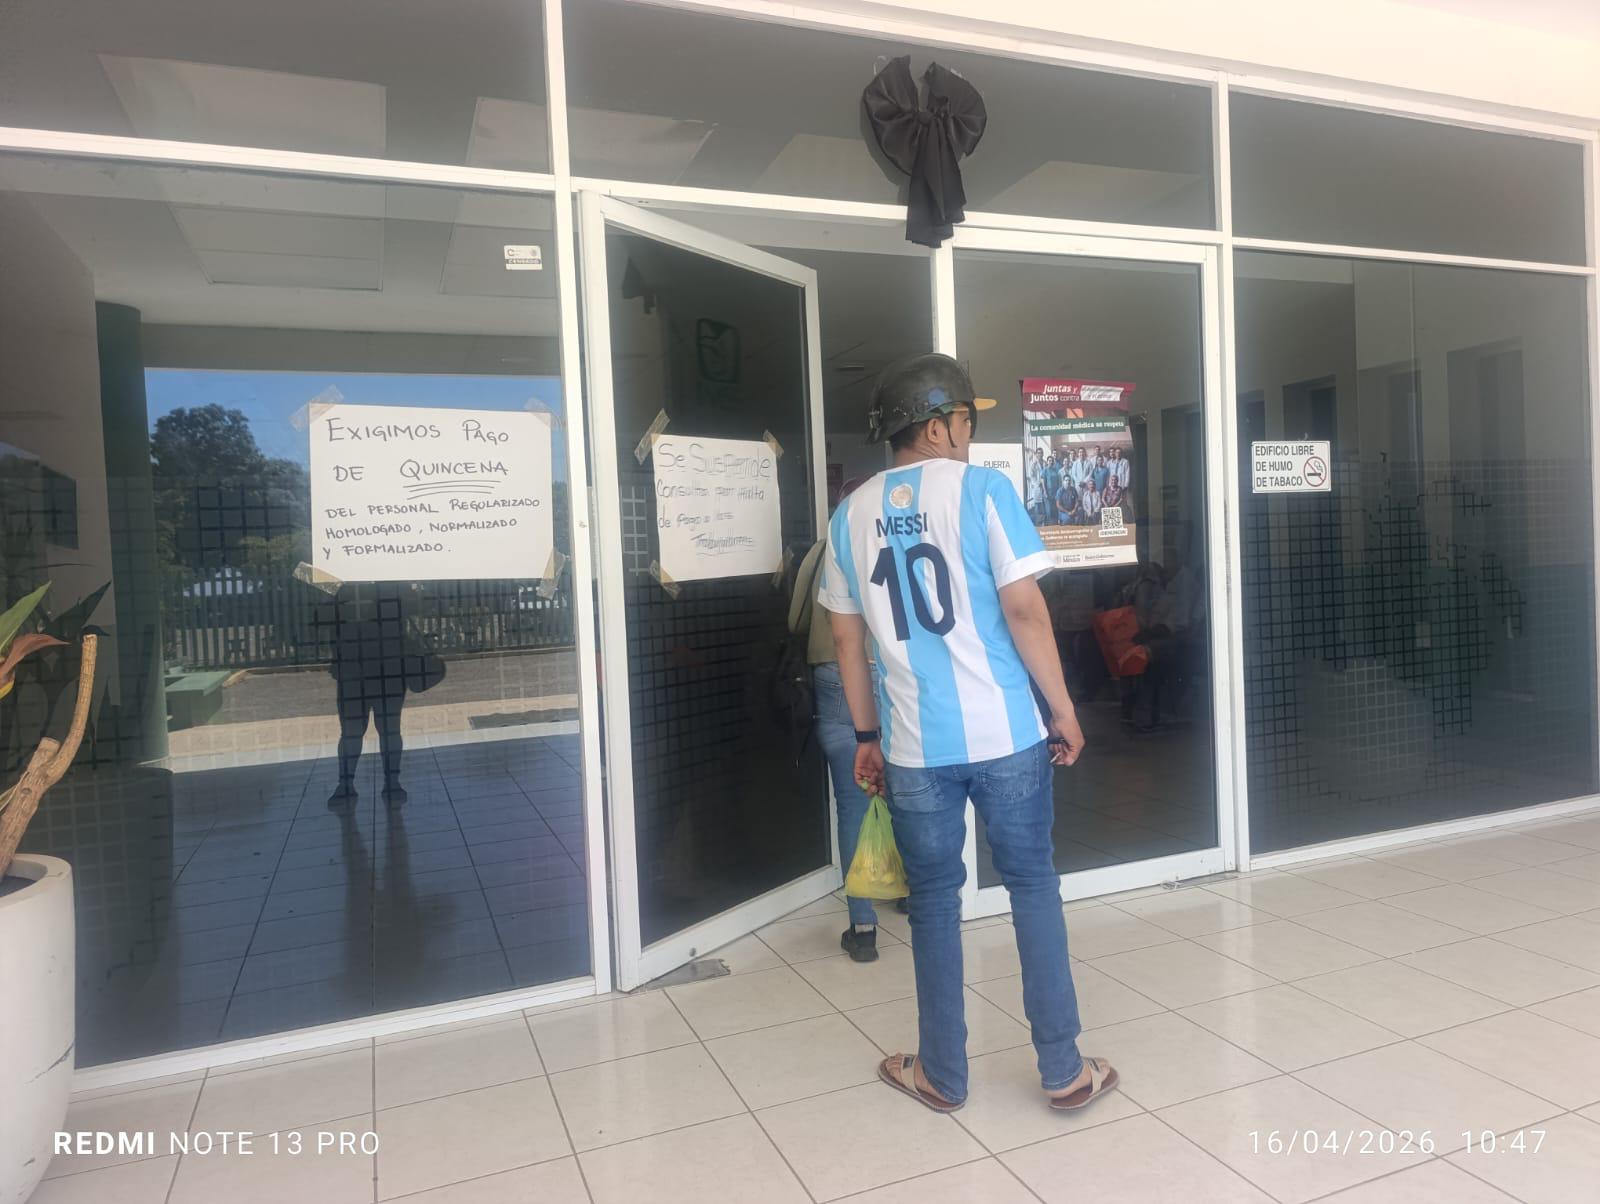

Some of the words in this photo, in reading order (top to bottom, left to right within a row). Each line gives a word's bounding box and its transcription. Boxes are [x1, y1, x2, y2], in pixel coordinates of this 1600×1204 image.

[1043, 384, 1072, 394] Juntas
[1030, 394, 1059, 403] Juntos
[326, 417, 441, 442] EXIGIMOS
[658, 442, 685, 468] Se
[1255, 445, 1289, 456] EDIFICIO
[1291, 445, 1314, 455] LIBRE
[333, 464, 365, 481] DE
[399, 459, 509, 481] QUINCENA
[983, 460, 1011, 469] PUERTA
[1255, 461, 1267, 471] DE
[1269, 461, 1293, 471] HUMO
[1256, 477, 1267, 487] DE
[1269, 476, 1303, 487] TABACO
[325, 507, 357, 519] DEL
[368, 502, 439, 516] PERSONAL
[429, 518, 517, 533] NORMALIZADO
[875, 512, 928, 538] MESSI
[870, 542, 956, 641] 10
